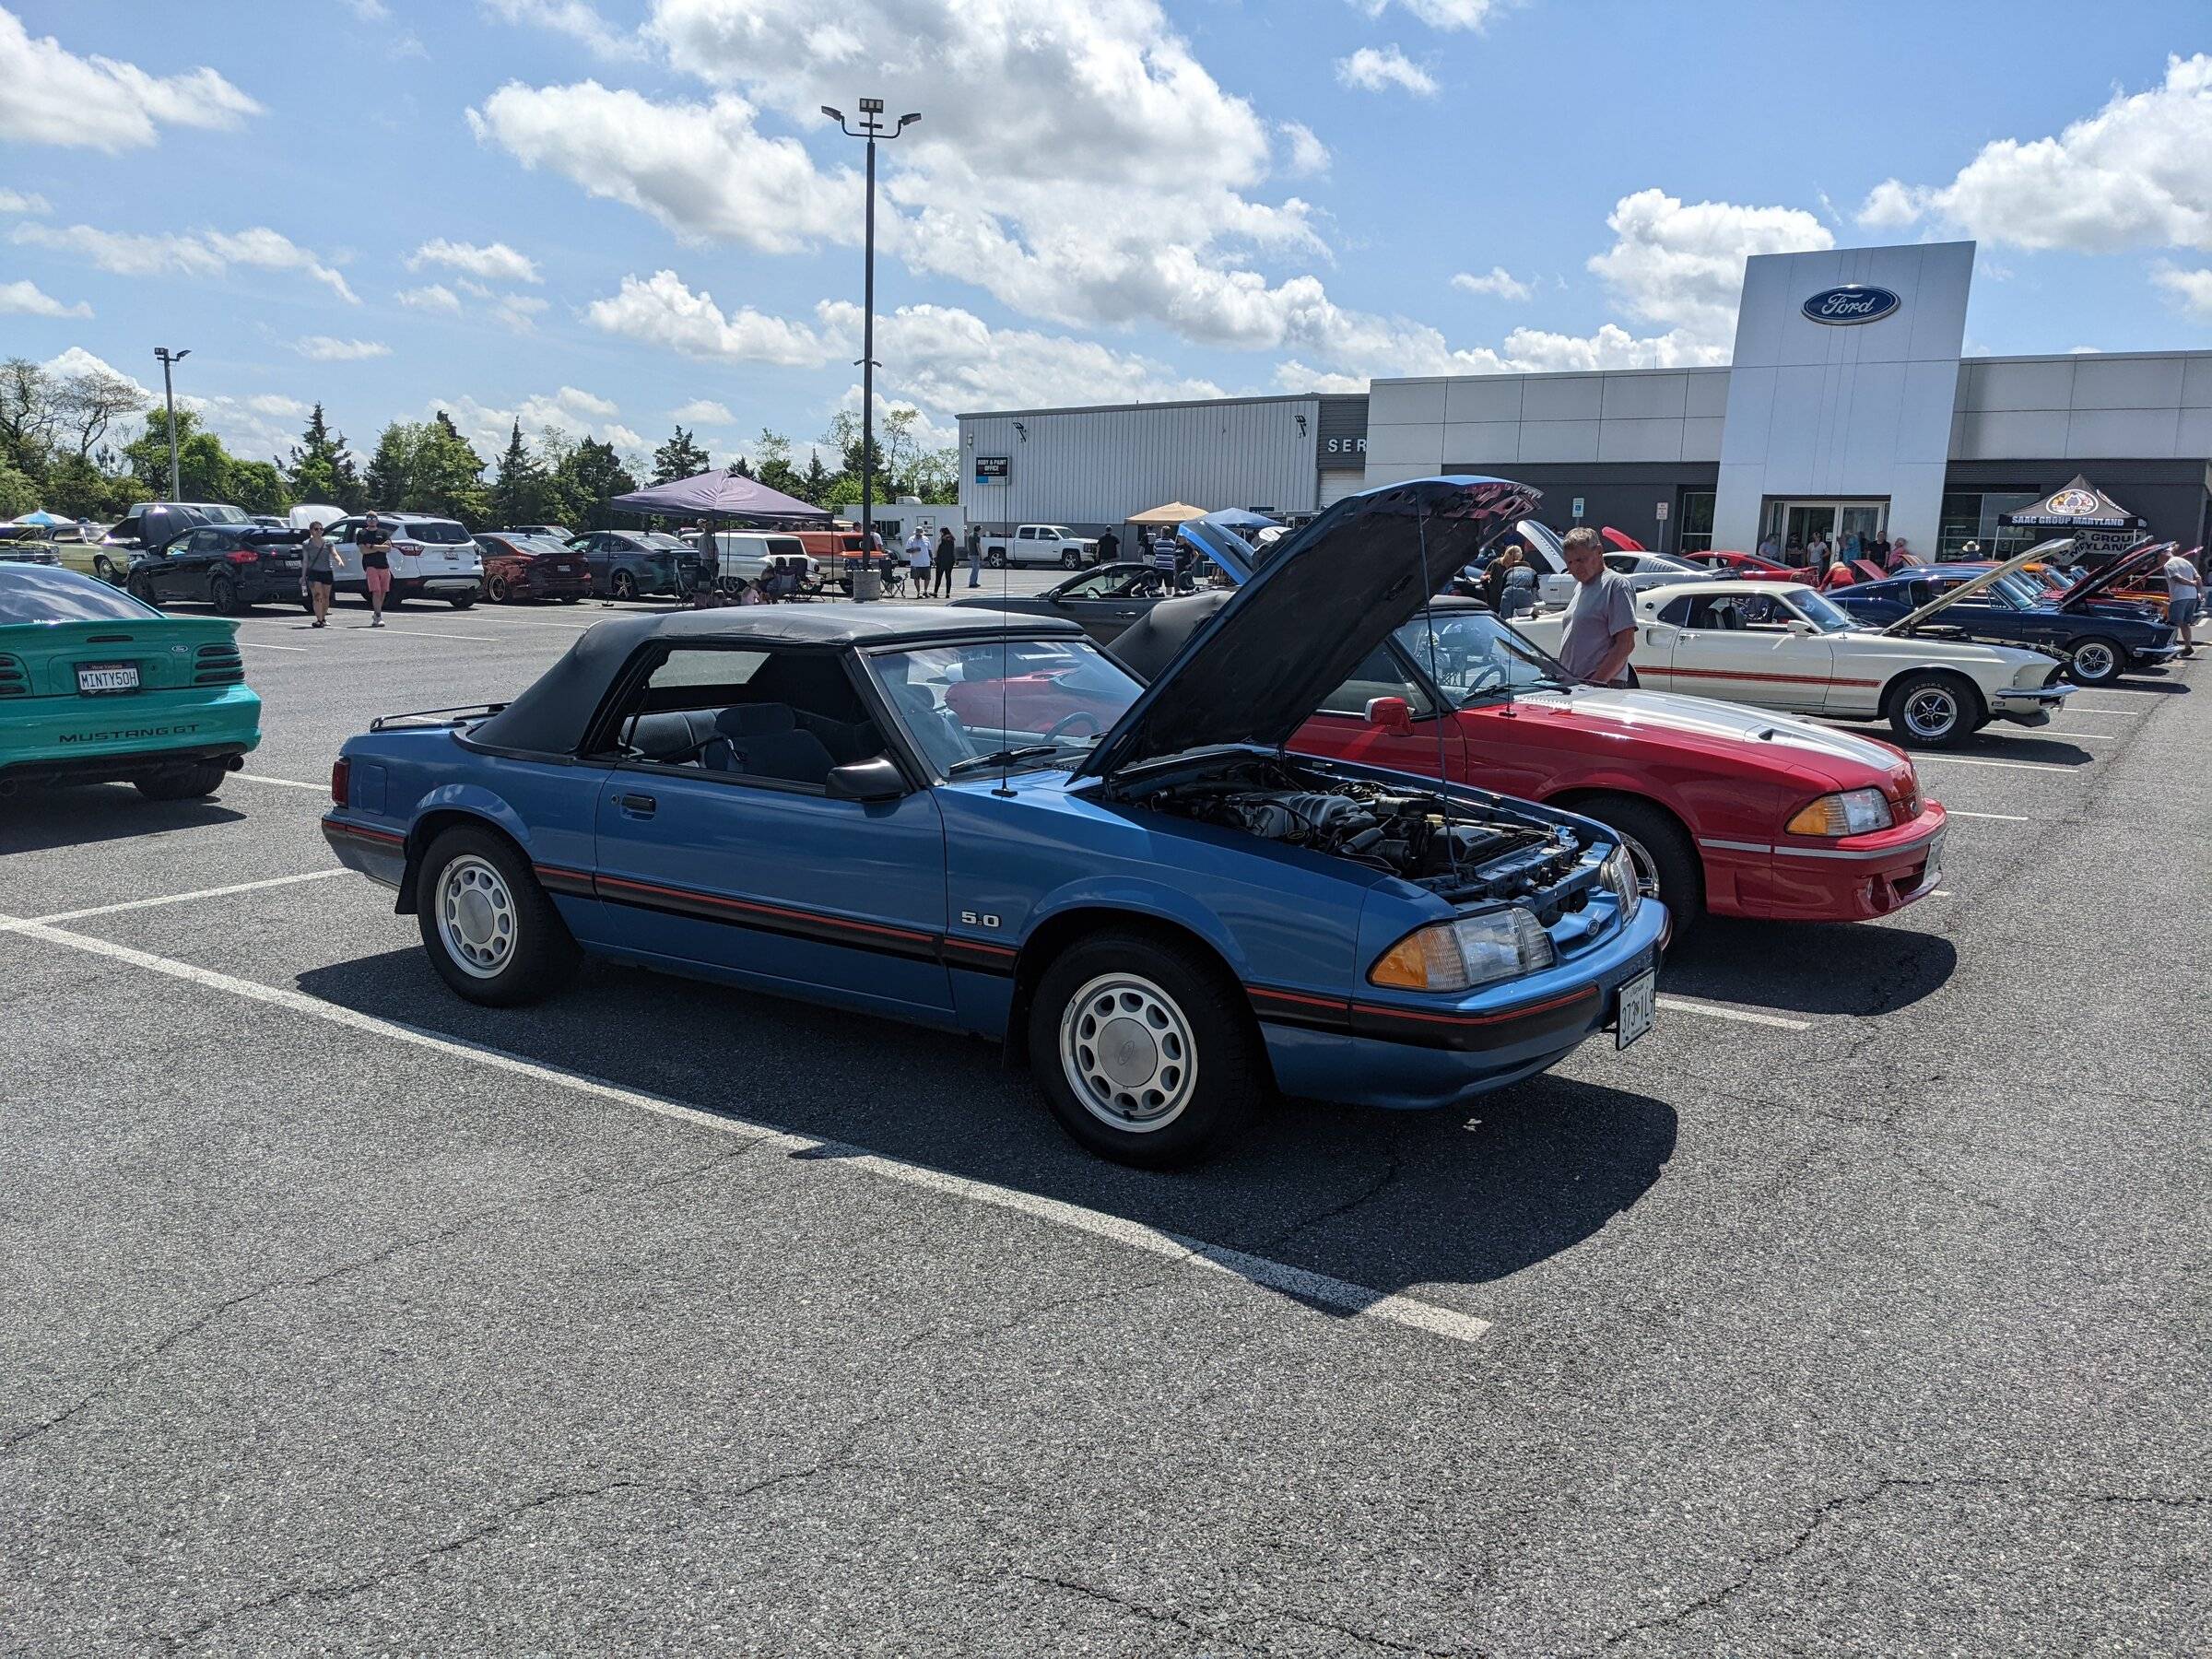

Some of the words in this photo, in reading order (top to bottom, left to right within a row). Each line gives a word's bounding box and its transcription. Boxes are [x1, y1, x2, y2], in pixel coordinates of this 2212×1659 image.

[1821, 293, 1876, 314] Ford
[1328, 439, 1367, 453] SER
[2012, 516, 2037, 524] SAAC
[2039, 516, 2071, 524] GROUP
[2073, 517, 2124, 526] MARYLAND
[2091, 534, 2141, 543] GROUP
[59, 727, 169, 743] MUSTANG
[173, 724, 200, 734] GT
[961, 911, 1000, 927] 5.0
